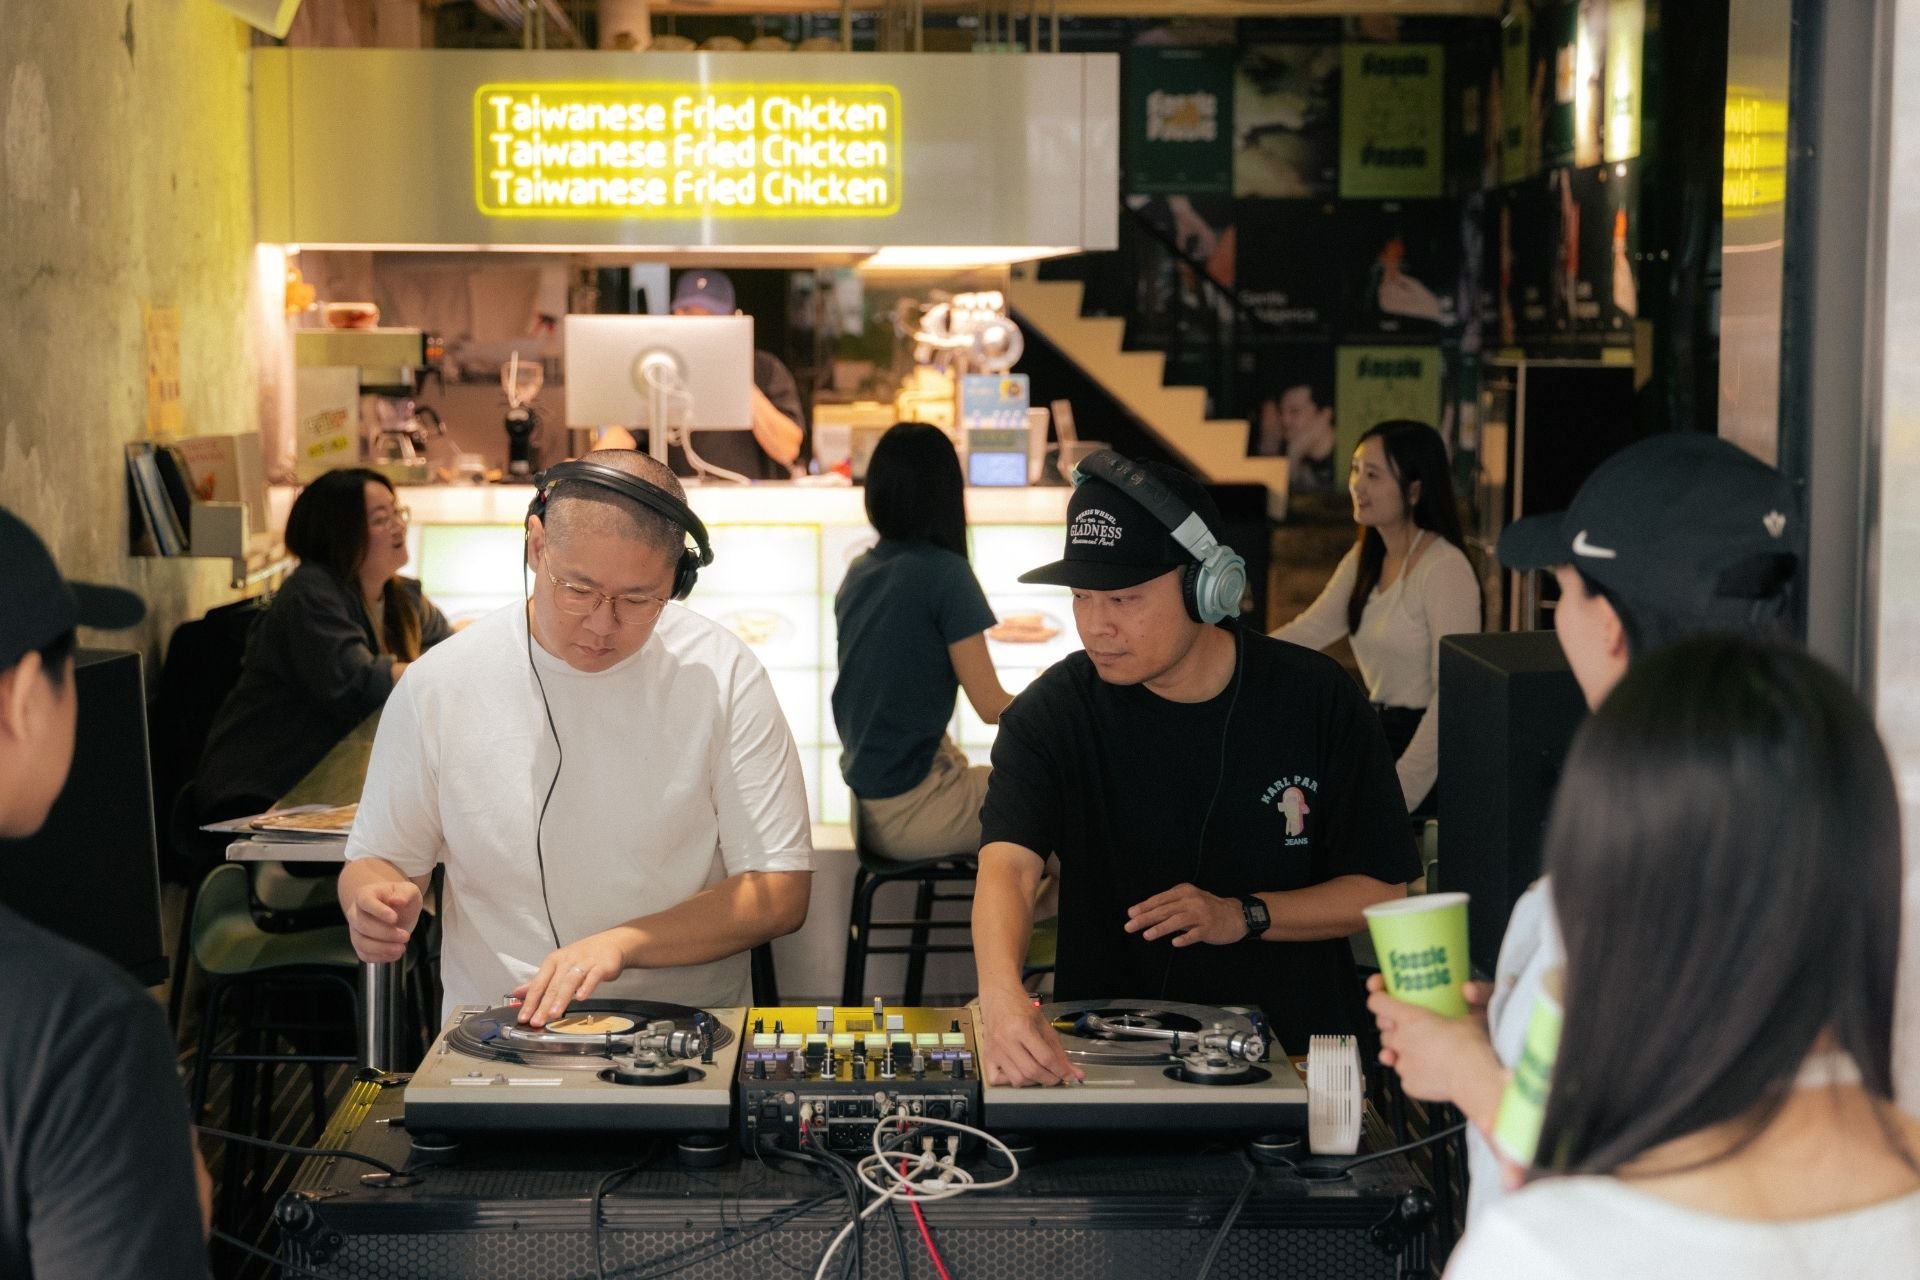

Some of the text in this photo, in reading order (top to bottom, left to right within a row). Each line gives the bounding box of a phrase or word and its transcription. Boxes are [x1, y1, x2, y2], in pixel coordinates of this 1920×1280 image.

[489, 95, 888, 131] Taiwanese Fried Chicken
[489, 132, 888, 168] Taiwanese Fried Chicken
[489, 169, 888, 206] Taiwanese Fried Chicken
[1094, 508, 1117, 525] WHEEL
[1070, 523, 1122, 539] GLADNESS
[1284, 837, 1309, 846] JEANS
